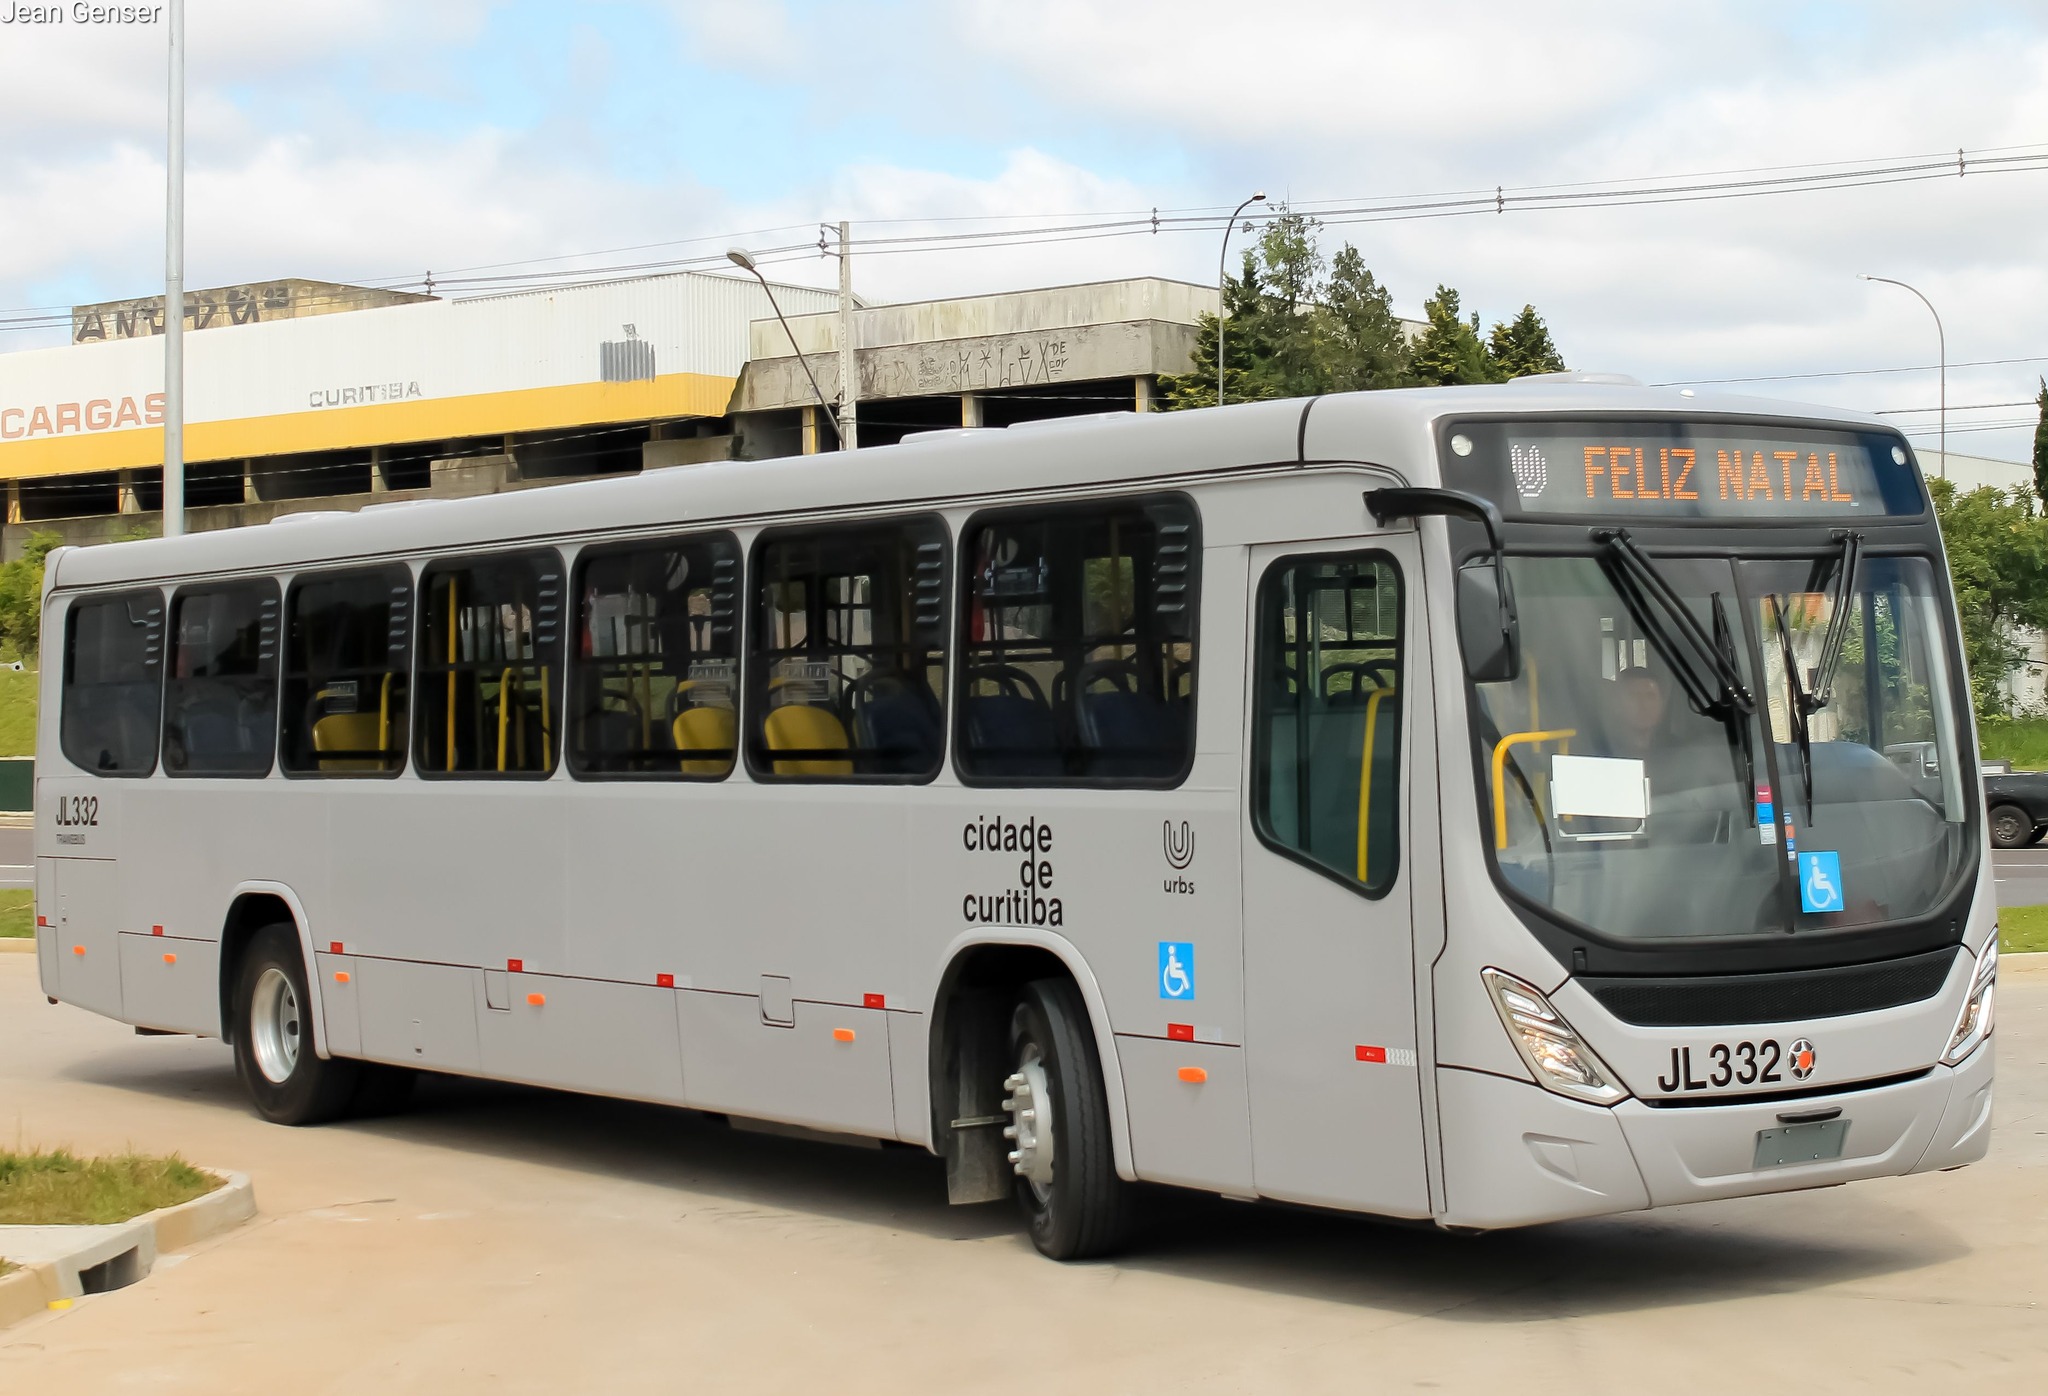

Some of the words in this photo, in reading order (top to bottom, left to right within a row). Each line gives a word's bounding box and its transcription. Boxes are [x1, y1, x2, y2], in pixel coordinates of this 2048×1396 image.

[309, 381, 422, 407] CURITIBA
[1, 393, 166, 438] CARGAS
[1584, 446, 1699, 499] FELIZ
[1717, 450, 1853, 502] NATAL
[56, 796, 98, 826] JL332
[963, 815, 1053, 853] cidade
[1020, 857, 1053, 889] de
[1163, 877, 1195, 895] urbs
[963, 889, 1063, 927] curitiba
[1657, 1039, 1782, 1092] JL332
